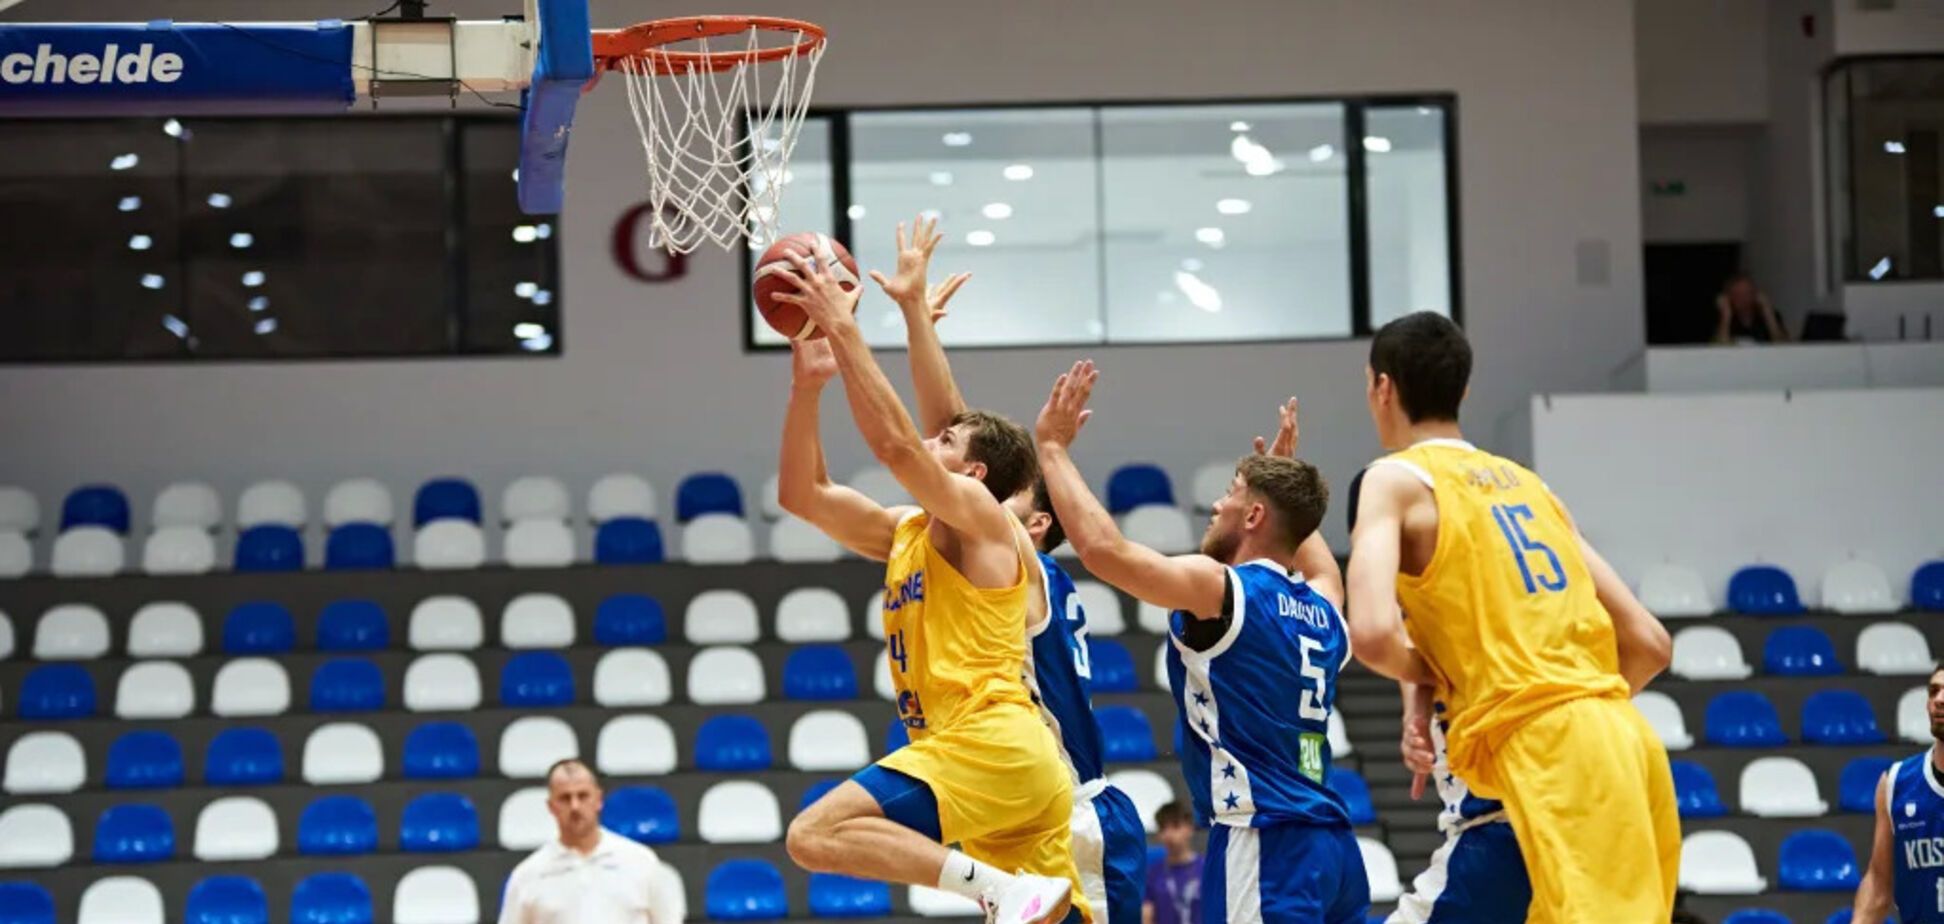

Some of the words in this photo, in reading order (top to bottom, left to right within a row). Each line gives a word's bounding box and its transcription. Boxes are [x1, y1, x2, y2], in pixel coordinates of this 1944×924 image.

[1, 43, 184, 84] chelde
[1491, 503, 1567, 593] 15
[1066, 592, 1092, 680] 3
[1299, 634, 1328, 721] 5
